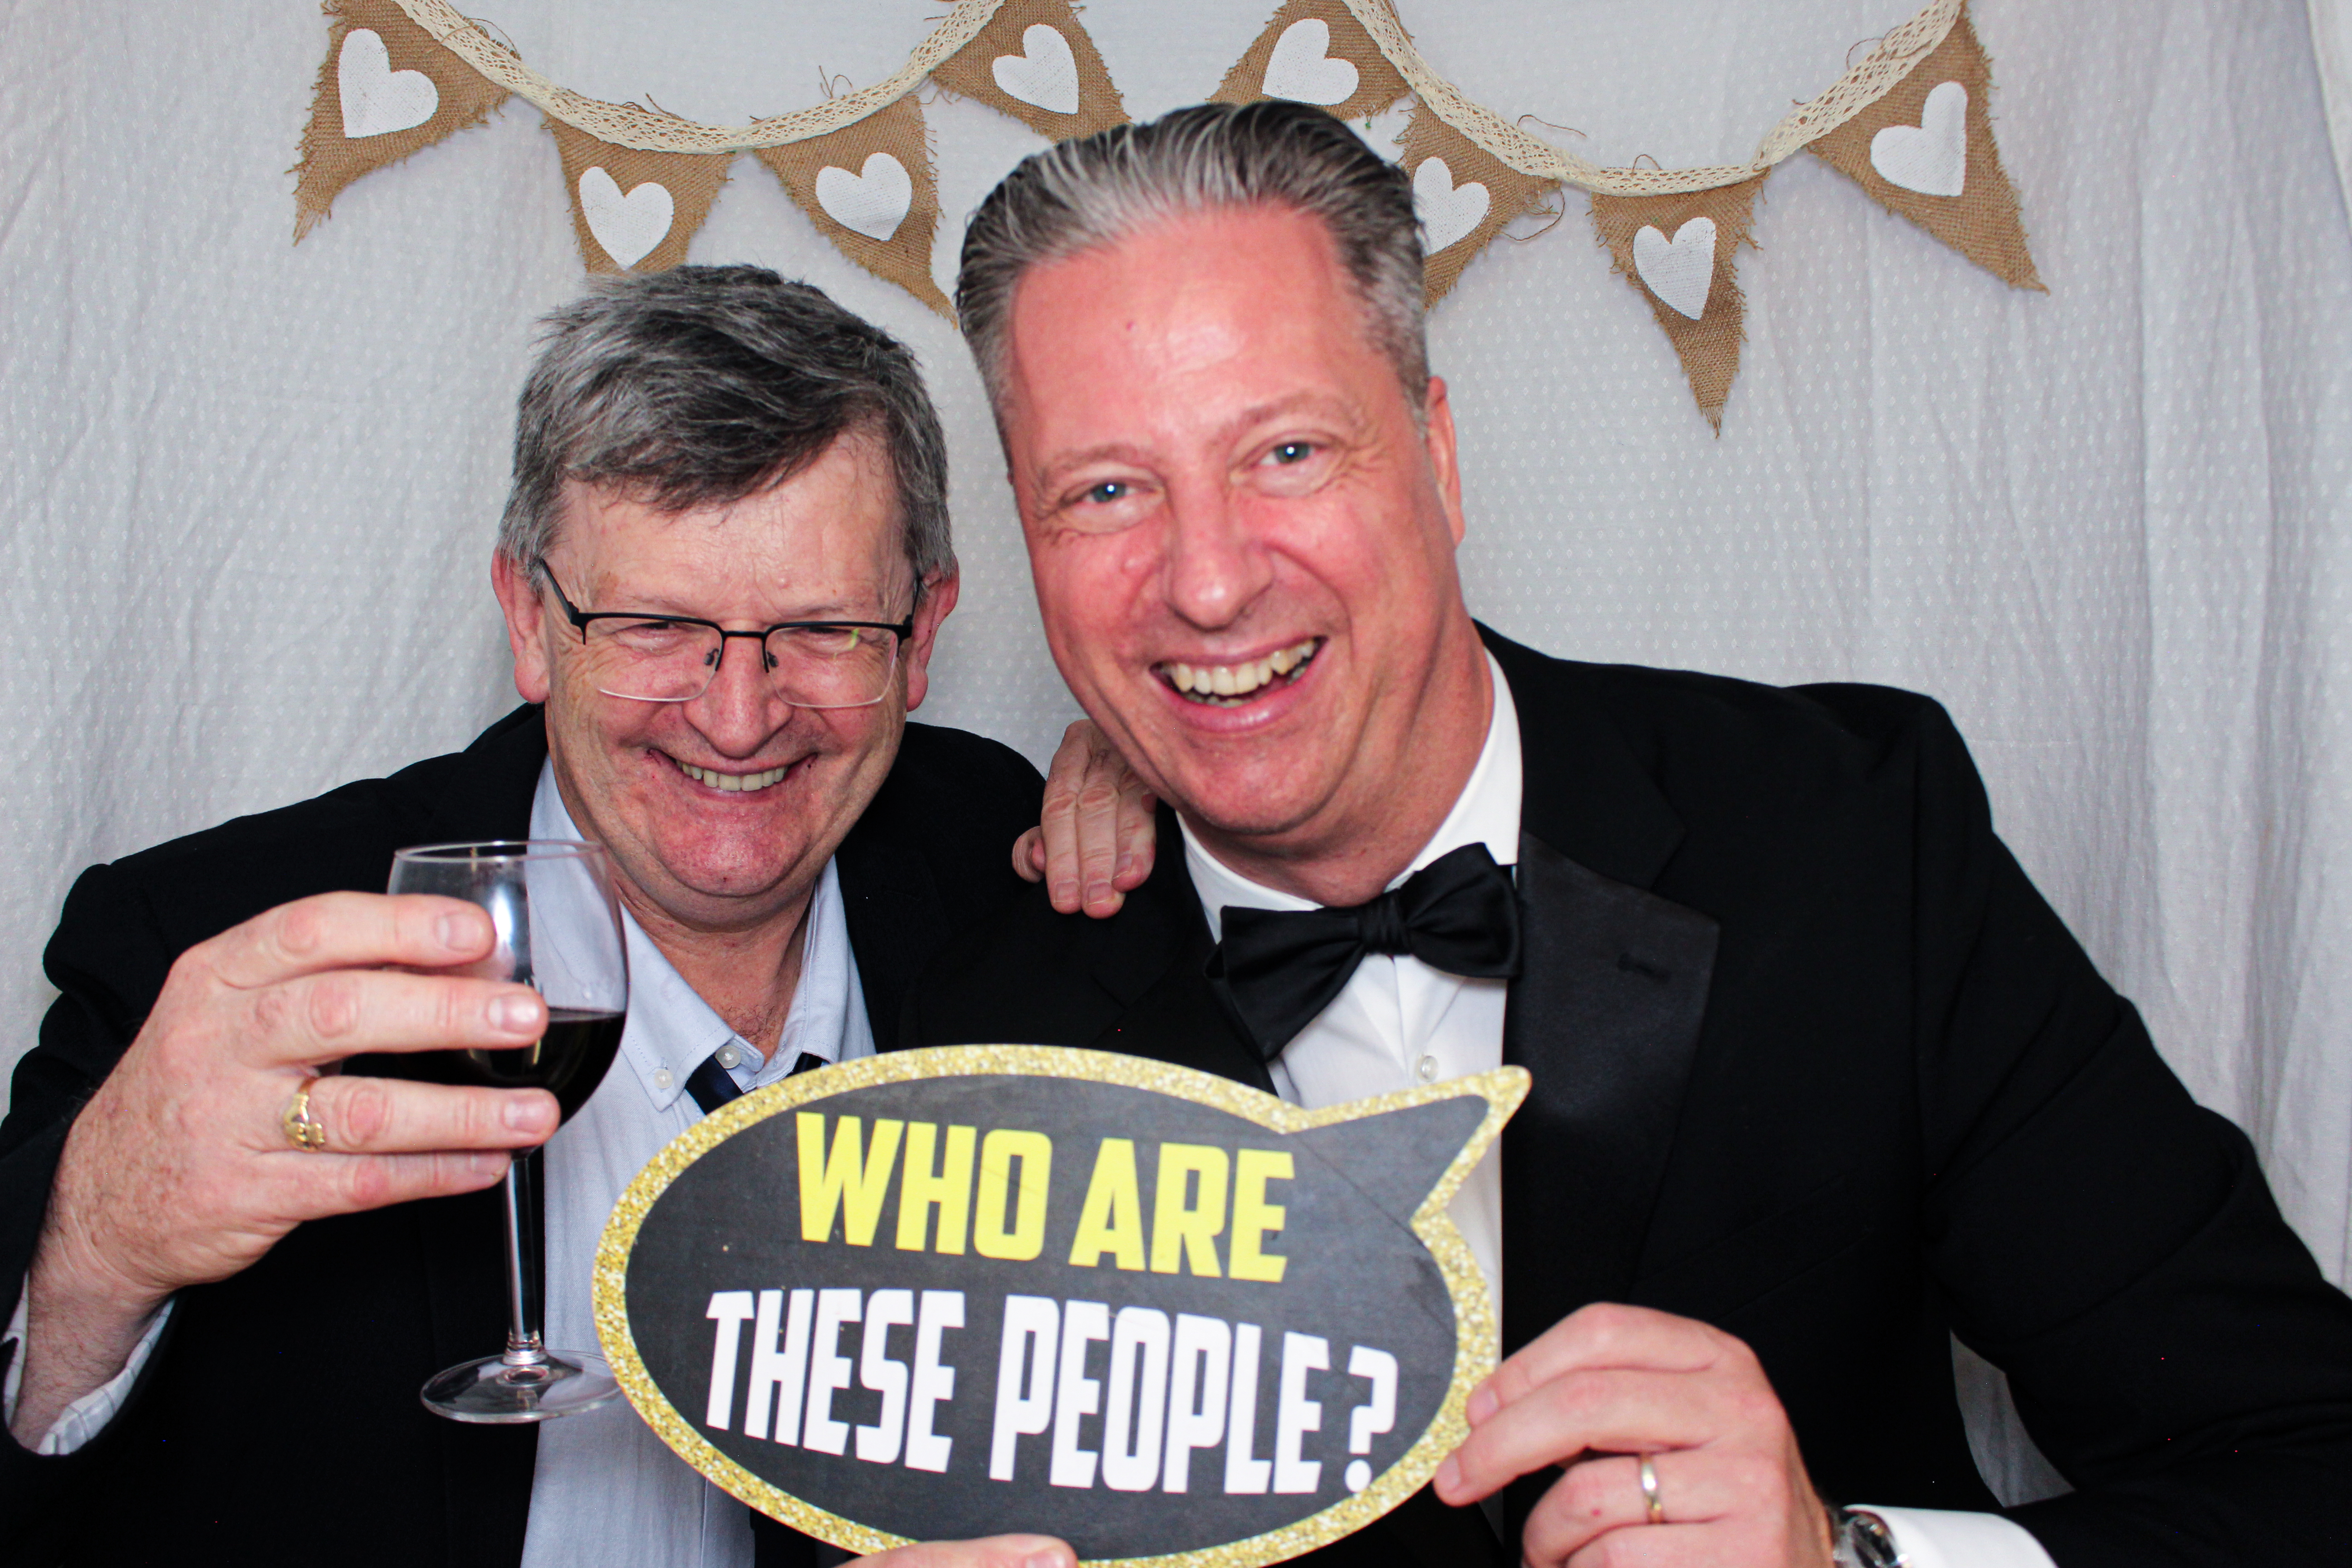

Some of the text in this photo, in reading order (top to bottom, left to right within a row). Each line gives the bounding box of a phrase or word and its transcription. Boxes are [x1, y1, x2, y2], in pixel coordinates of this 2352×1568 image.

[796, 1112, 1294, 1282] WHO ARE
[706, 1287, 1398, 1494] THESE PEOPLE?
